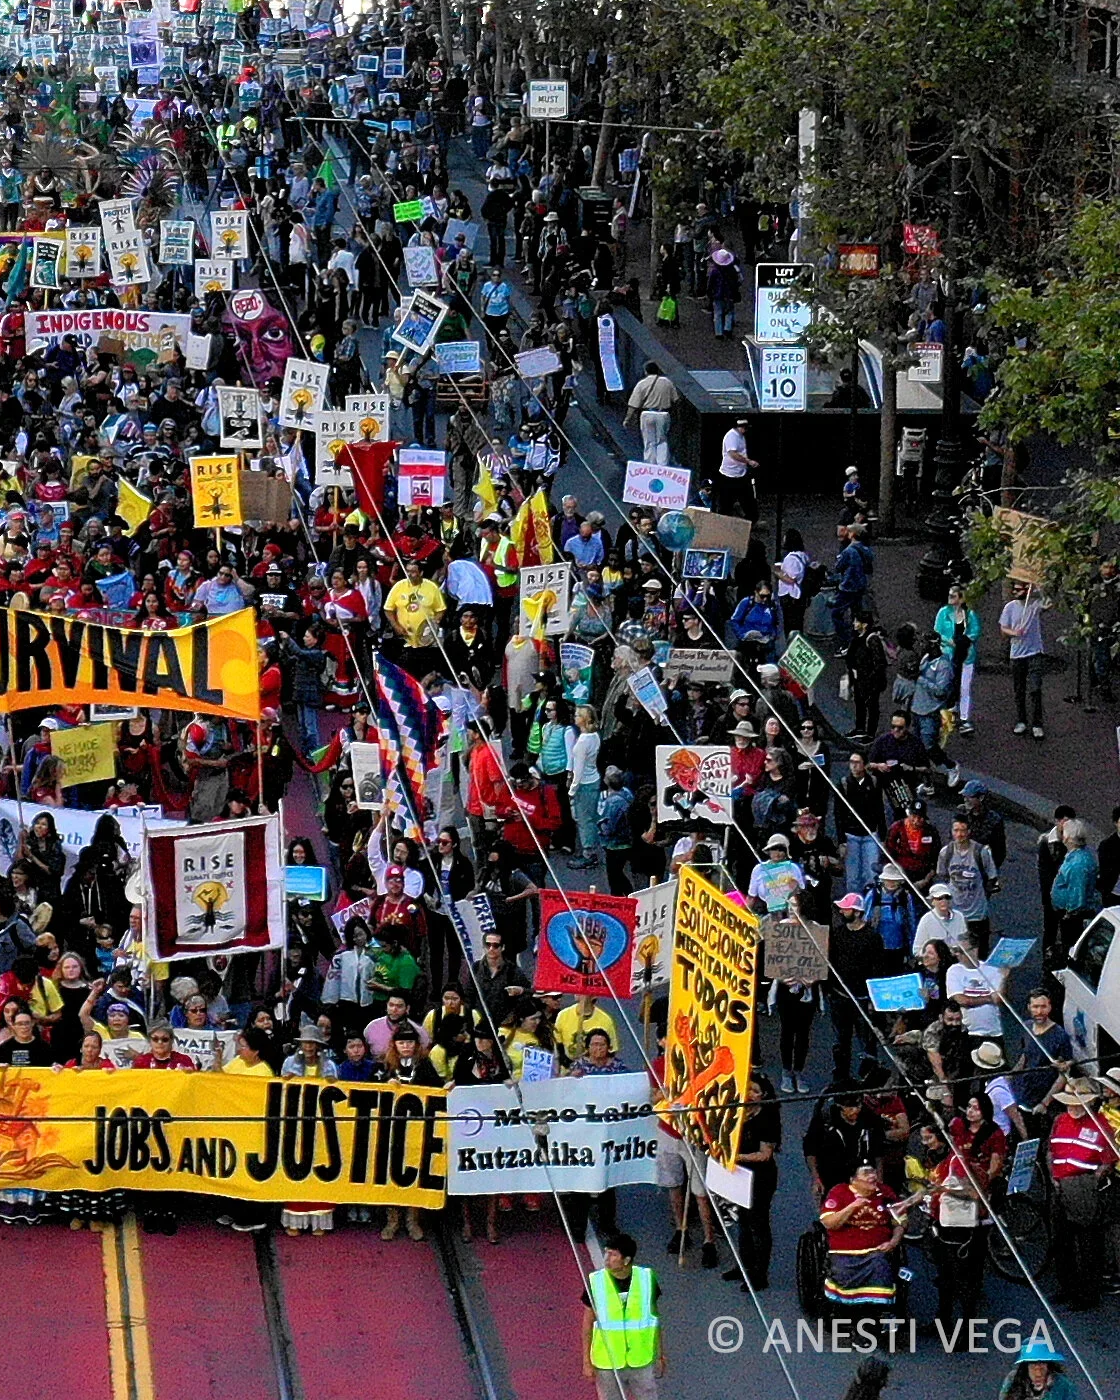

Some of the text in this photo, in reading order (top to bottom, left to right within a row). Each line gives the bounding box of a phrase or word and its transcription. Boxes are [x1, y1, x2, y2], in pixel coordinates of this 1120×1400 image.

[538, 95, 559, 103] MUST
[215, 216, 243, 225] RISE
[70, 232, 97, 240] RISE
[111, 238, 138, 250] RISE
[199, 266, 227, 275] RISE
[770, 305, 799, 313] TAXIS
[36, 311, 150, 334] INDIGENOUS
[770, 319, 797, 327] ONLY
[765, 353, 804, 362] SPEED
[768, 365, 799, 374] LIMIT
[290, 370, 321, 385] RISE
[770, 378, 796, 398] 10
[352, 401, 385, 411] RISE
[321, 422, 355, 432] RISE
[196, 463, 233, 475] RISE
[629, 467, 688, 486] LOCAL CARBON
[626, 486, 685, 505] REGULATION
[527, 570, 565, 584] RISE
[183, 854, 234, 873] RISE
[684, 878, 756, 947] SI QUEREMOS
[677, 901, 754, 975] SOLUCIONES
[773, 925, 808, 940] SOIL
[676, 932, 751, 996] NECESITAMOS
[677, 954, 750, 1033] TODOS
[175, 1038, 225, 1050] WATR
[525, 1049, 551, 1064] RISE
[585, 1102, 654, 1123] Lake
[83, 1080, 448, 1191] JOBS AND JUSTICE
[457, 1135, 658, 1173] Kutzadika Tribe
